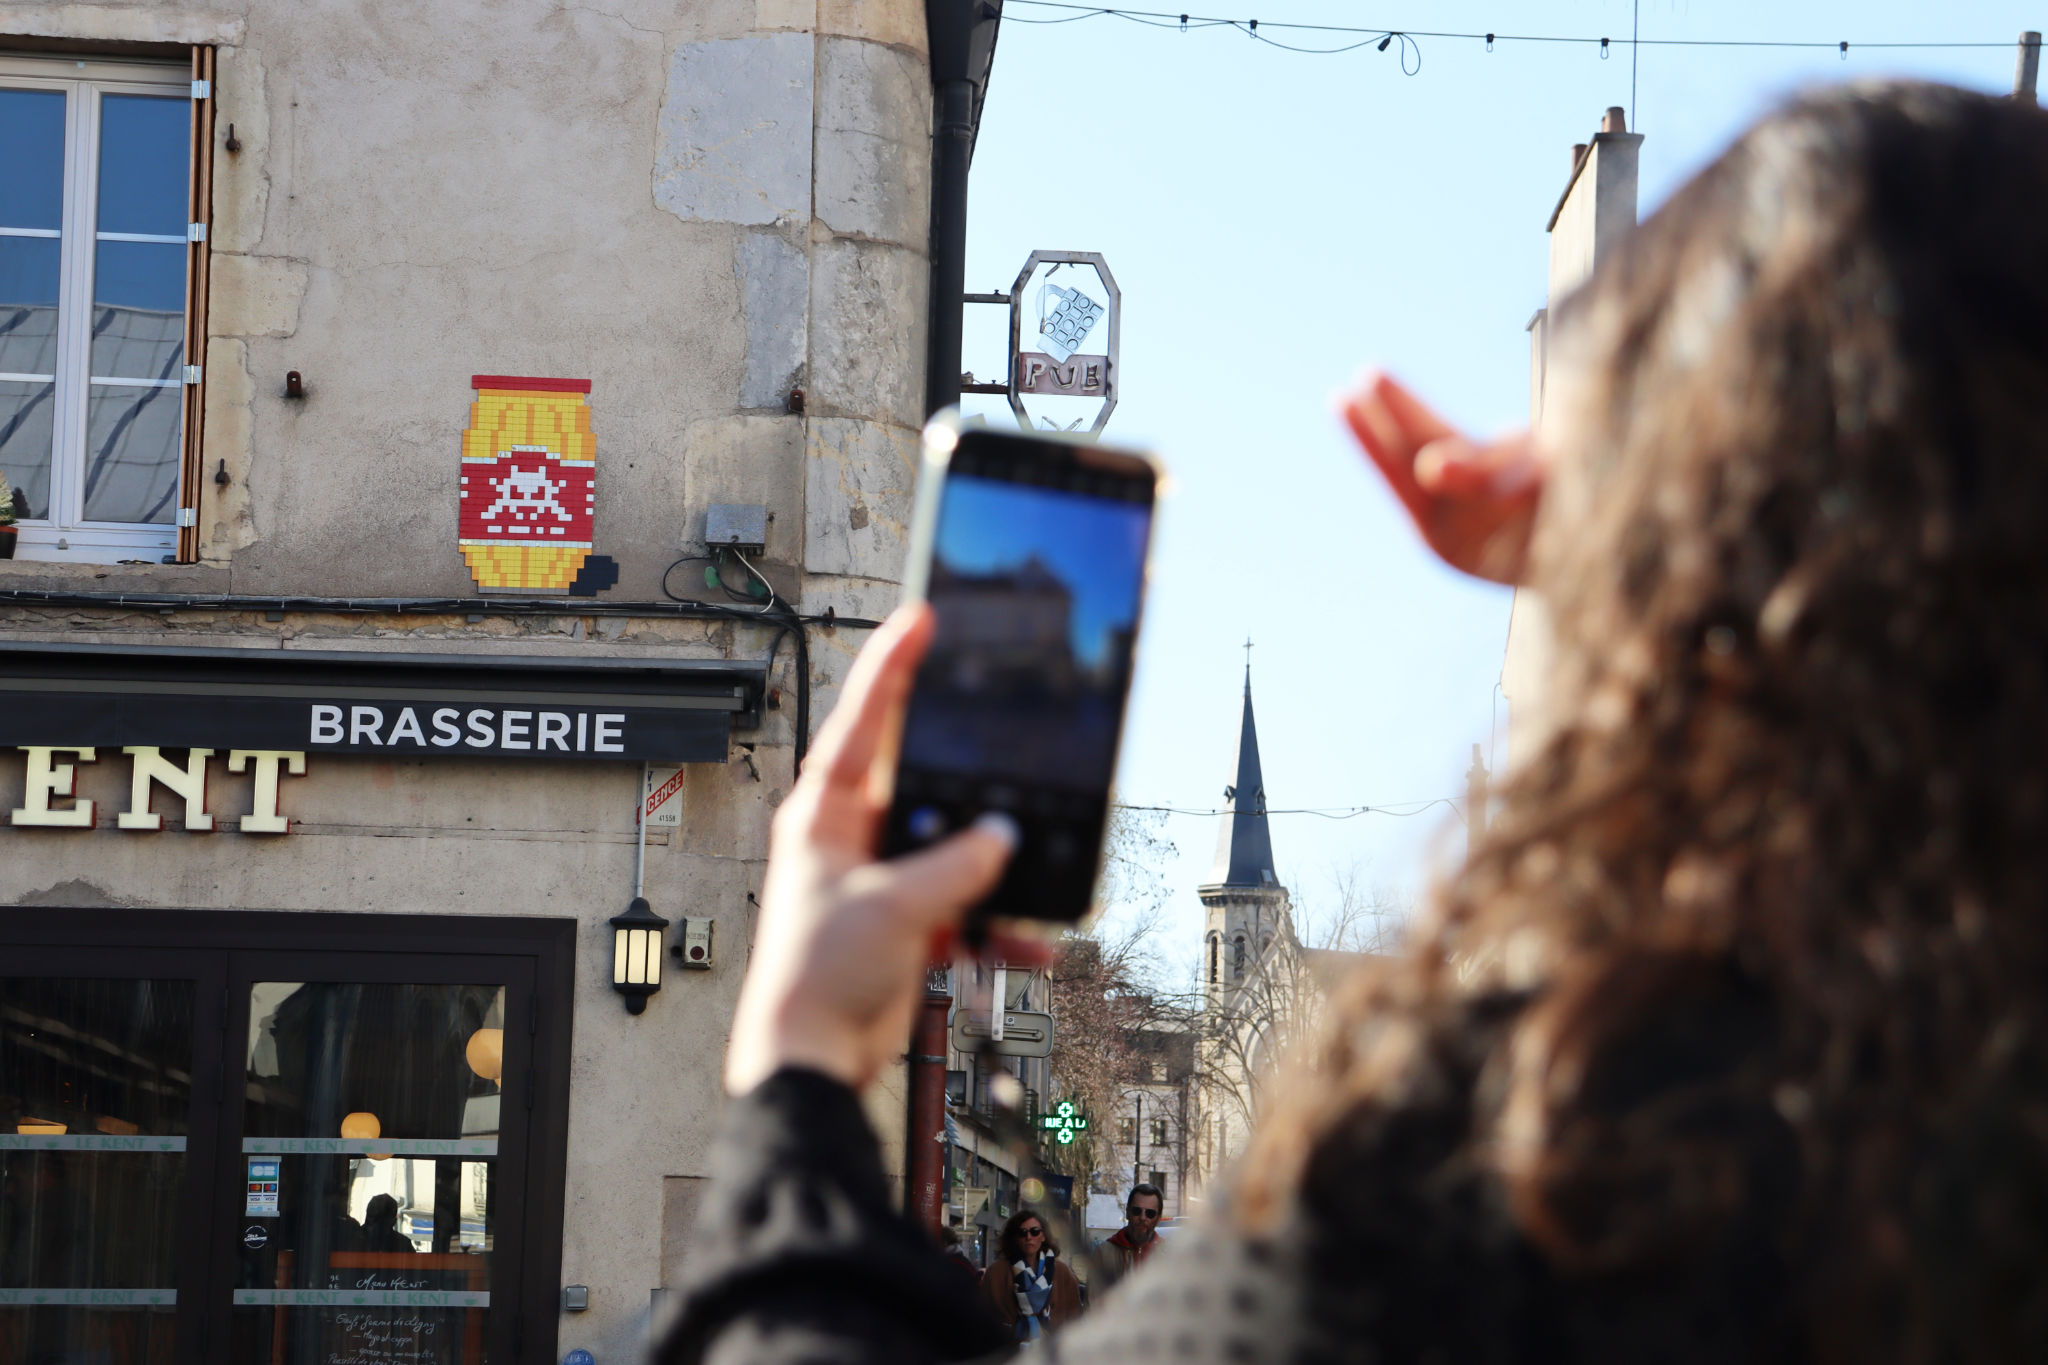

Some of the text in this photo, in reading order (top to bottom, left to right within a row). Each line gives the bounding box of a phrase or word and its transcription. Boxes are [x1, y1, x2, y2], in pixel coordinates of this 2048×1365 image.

[1024, 357, 1100, 391] PUB
[310, 704, 625, 753] BRASSERIE
[11, 745, 308, 834] ENT
[646, 771, 682, 813] CENCE
[75, 1136, 146, 1150] LE KENT
[280, 1140, 346, 1152] LE KENT
[415, 1141, 458, 1154] KENT
[90, 1290, 137, 1304] KENT
[270, 1290, 340, 1304] LE KENT
[383, 1292, 452, 1305] LE KENT
